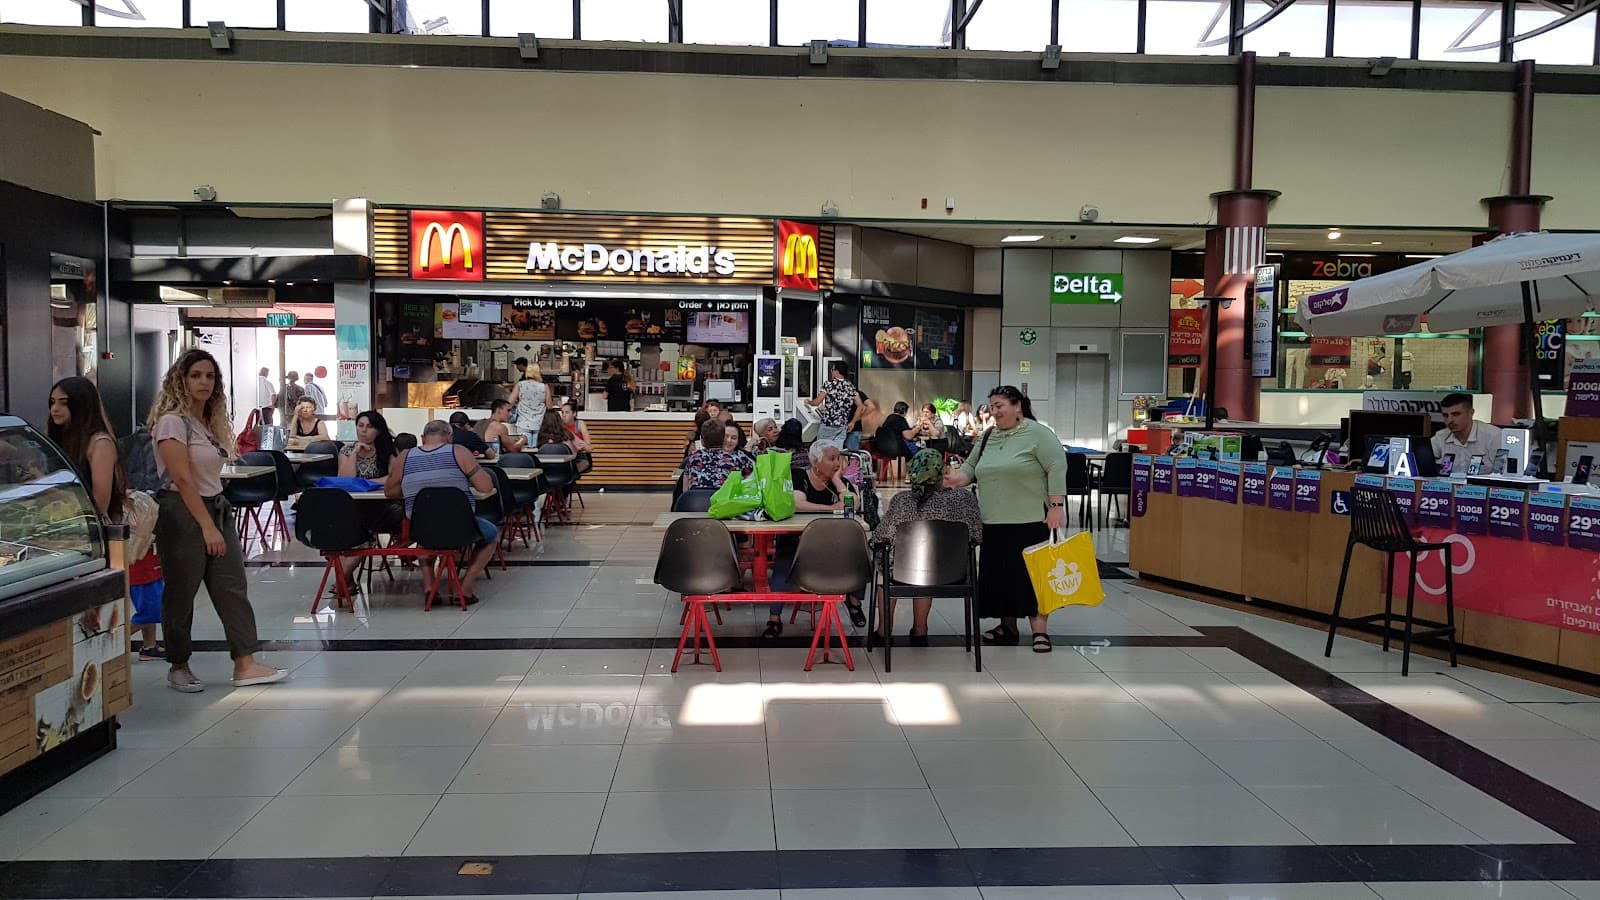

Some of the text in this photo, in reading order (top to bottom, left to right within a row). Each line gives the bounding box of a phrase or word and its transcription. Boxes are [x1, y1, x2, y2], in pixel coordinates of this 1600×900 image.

[525, 242, 736, 275] McDonald's
[1054, 275, 1112, 293] Delta
[514, 298, 532, 306] Pick
[533, 299, 546, 308] Up
[554, 299, 568, 309] כאן
[678, 301, 703, 309] Order
[716, 302, 730, 311] כאן
[1313, 298, 1334, 310] סלקום
[268, 314, 292, 326] יציאה
[1506, 435, 1521, 444] S9+
[1394, 453, 1412, 478] A
[1218, 477, 1237, 487] 100GB
[1271, 483, 1290, 491] 100GB
[1456, 505, 1483, 515] 100GB
[1530, 512, 1559, 524] 100GB
[1053, 578, 1079, 592] KIWI
[1546, 598, 1593, 614] ואביזרים
